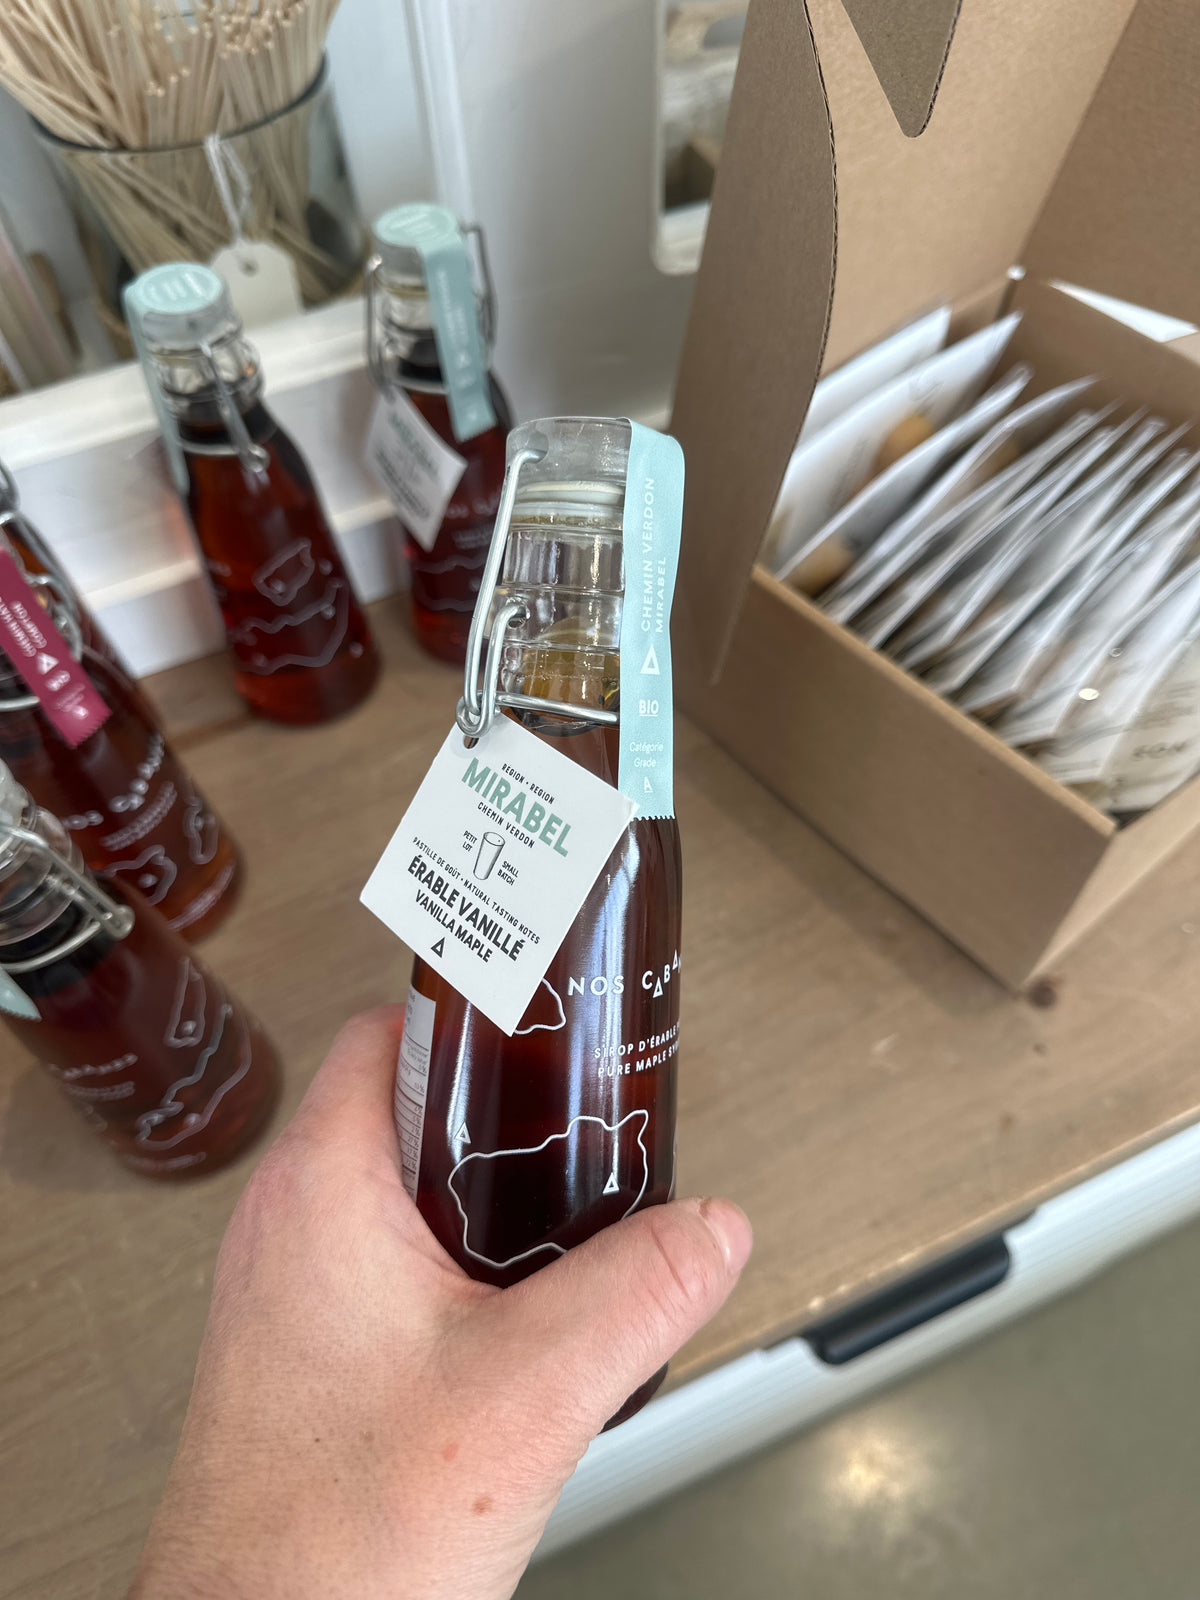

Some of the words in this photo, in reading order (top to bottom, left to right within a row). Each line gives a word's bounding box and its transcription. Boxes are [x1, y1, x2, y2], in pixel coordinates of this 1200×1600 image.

[642, 477, 655, 554] VERDON
[640, 559, 654, 632] CHEMIN
[655, 556, 667, 633] MIRABEL
[638, 699, 660, 714] BIO
[634, 757, 657, 769] Grade
[529, 783, 555, 805] REGION
[461, 757, 571, 858] MIRABEL
[463, 830, 478, 845] PETIT
[477, 801, 505, 826] CHEMIN
[505, 822, 536, 849] VERDON
[462, 841, 473, 852] LOT
[497, 868, 516, 886] BATCH
[501, 860, 520, 878] SMALL
[412, 836, 438, 861] PASTILLE
[437, 857, 446, 868] DE
[463, 879, 491, 905] NATURAL
[491, 901, 519, 927] TASTING
[518, 923, 541, 945] NOTES
[407, 854, 460, 909] ÉRABLE
[458, 896, 526, 962] VANILLÉ
[415, 888, 456, 934] VANILLA
[454, 924, 493, 963] MAPLE
[567, 975, 625, 996] NOS
[594, 1043, 634, 1059] SIROP
[598, 1062, 631, 1078] PURE
[635, 1050, 667, 1072] MAPLE
